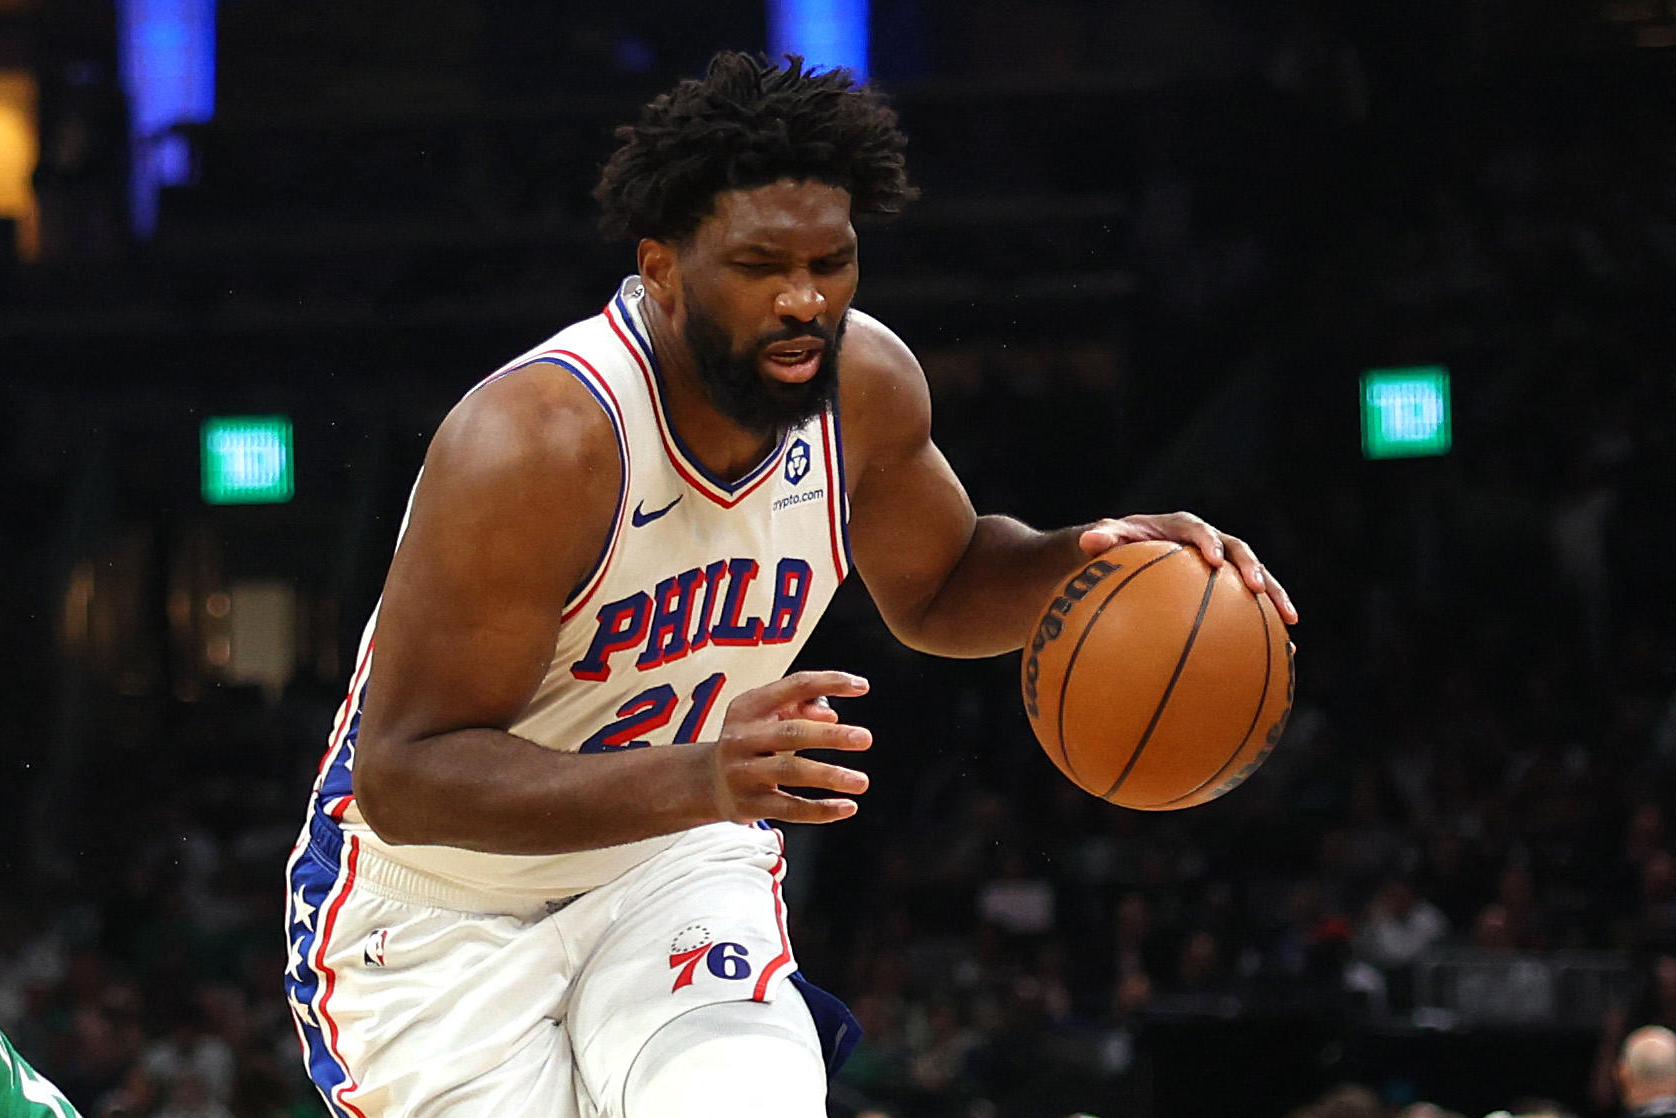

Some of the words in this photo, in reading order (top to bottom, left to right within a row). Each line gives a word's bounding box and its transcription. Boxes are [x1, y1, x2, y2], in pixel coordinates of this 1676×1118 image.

[570, 557, 813, 682] PHILA
[578, 672, 726, 754] 21
[669, 941, 751, 994] 76
